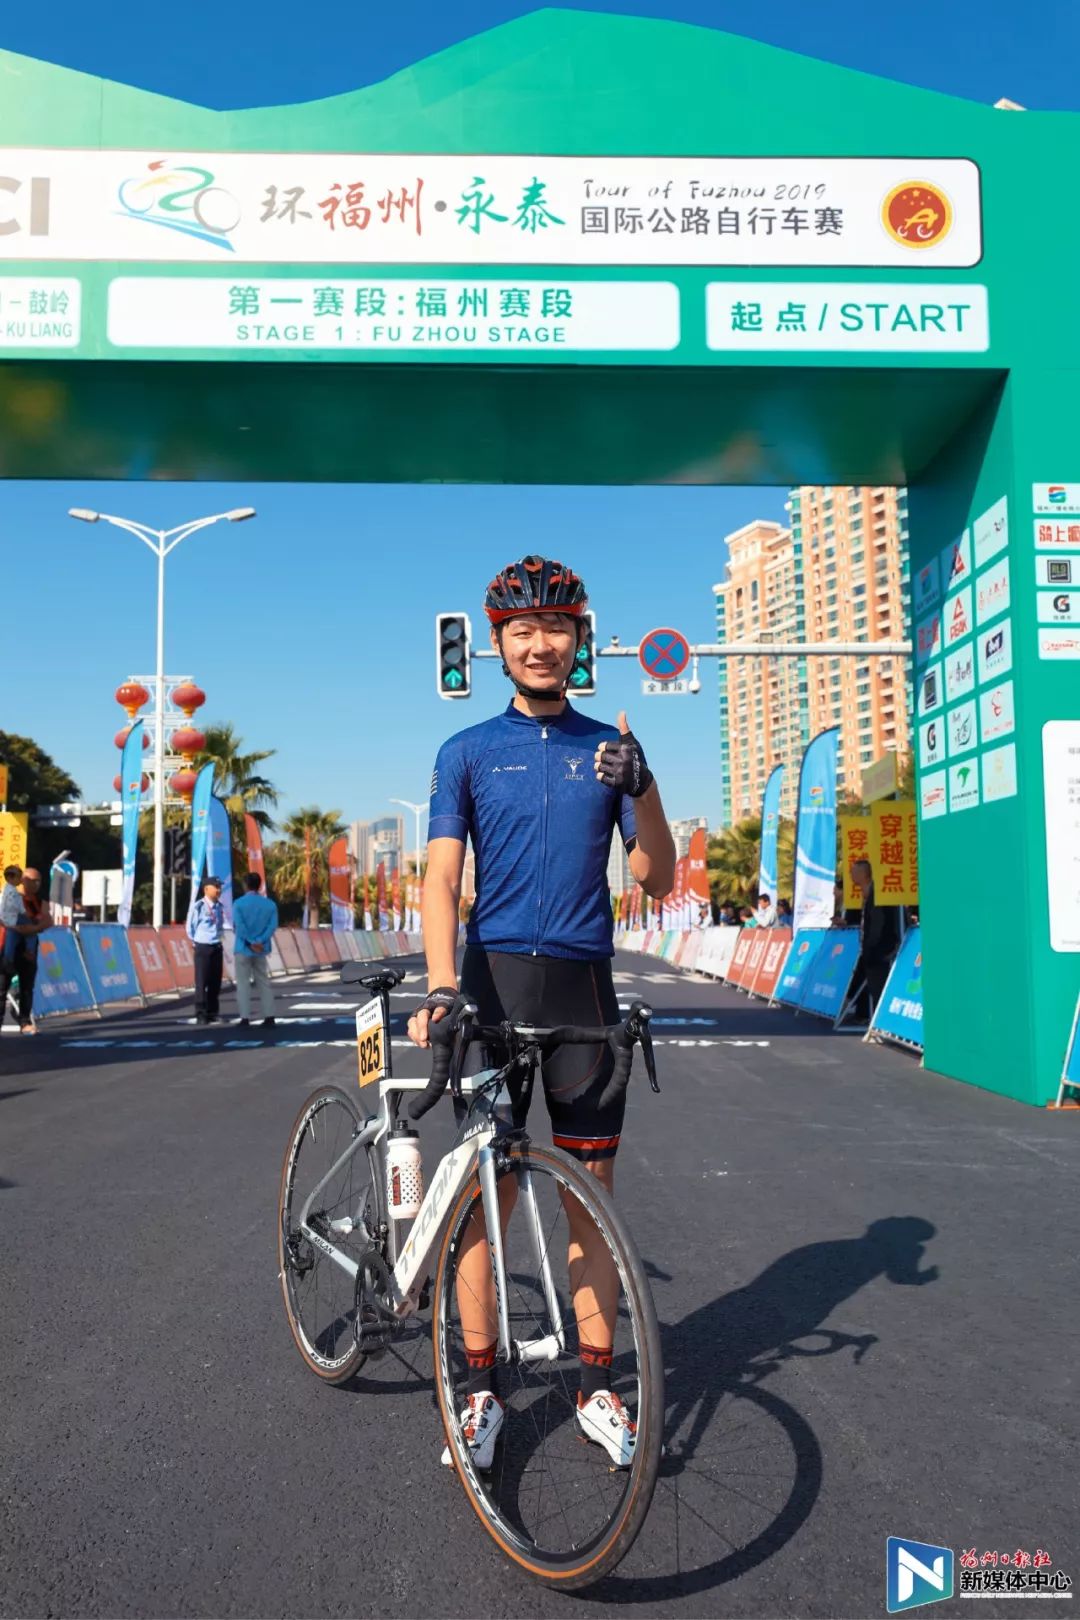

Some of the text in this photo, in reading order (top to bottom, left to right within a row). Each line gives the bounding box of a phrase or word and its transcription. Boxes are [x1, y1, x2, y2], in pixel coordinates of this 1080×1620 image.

[584, 180, 827, 200] Tour of Fuzhou 2019
[581, 206, 845, 236] 国际公路自行车赛
[6, 321, 72, 338] KU LIANG
[236, 324, 315, 341] STAGE
[373, 326, 401, 342] FU
[412, 326, 476, 342] ZHOU
[488, 326, 566, 343] STAGE
[10, 825, 21, 866] CROS
[880, 813, 904, 893] 穿越点
[908, 813, 918, 893] CROSSING
[360, 1032, 380, 1077] 825
[313, 1236, 334, 1254] MILAN
